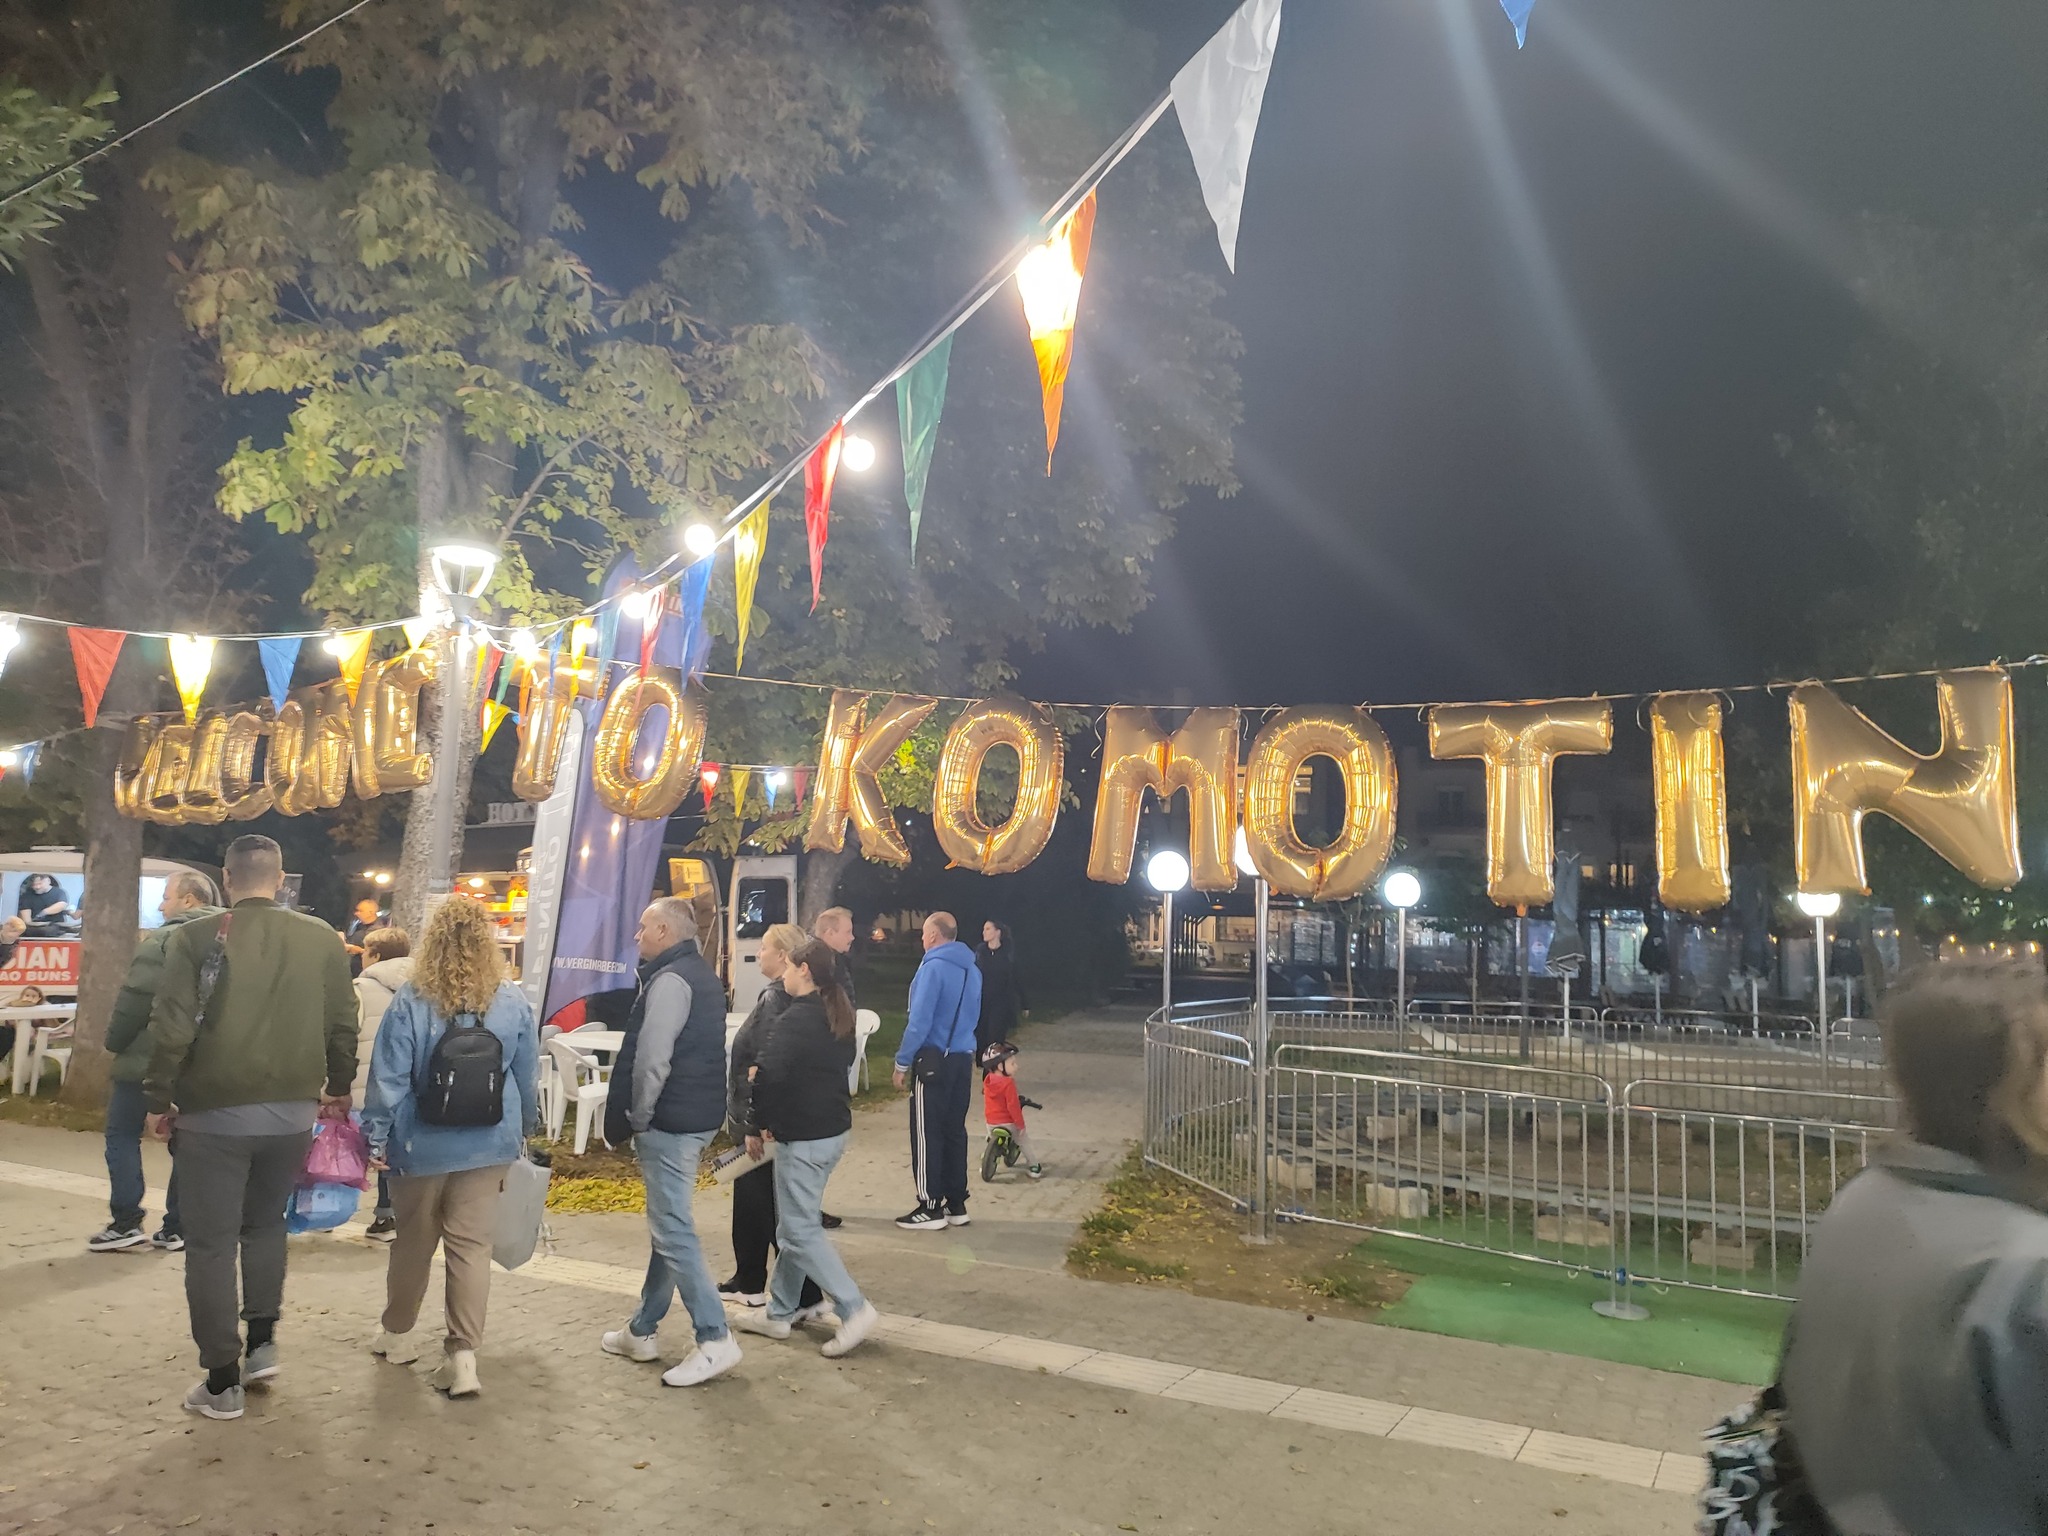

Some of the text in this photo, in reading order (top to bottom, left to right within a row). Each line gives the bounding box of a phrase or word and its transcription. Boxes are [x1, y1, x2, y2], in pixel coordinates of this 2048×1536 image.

[801, 664, 2023, 914] KOMOTIN
[2, 946, 70, 970] IAN
[26, 971, 71, 981] BUNS
